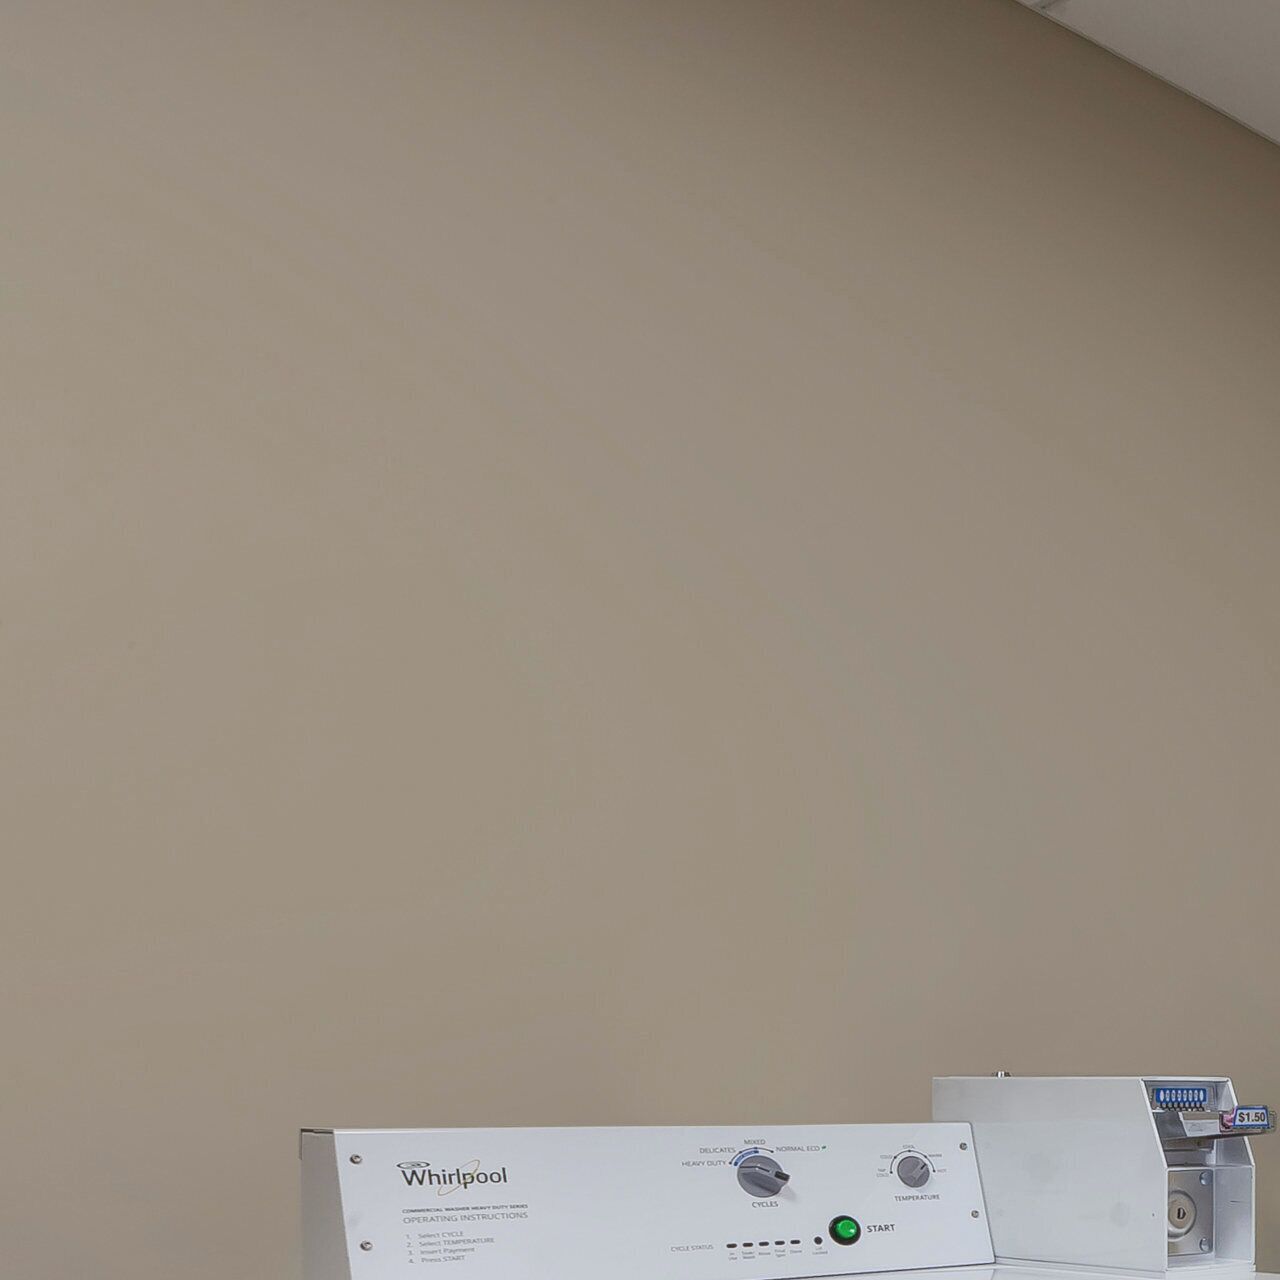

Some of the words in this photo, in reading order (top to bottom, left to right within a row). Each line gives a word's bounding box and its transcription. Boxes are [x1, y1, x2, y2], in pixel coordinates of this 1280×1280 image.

[1238, 1112, 1266, 1122] $1.50
[401, 1166, 508, 1190] Whirlpool
[894, 1194, 940, 1202] TEMPERATURE
[403, 1214, 458, 1225] OPERATING
[460, 1212, 528, 1222] INSTRUCTIONS
[867, 1224, 895, 1233] START
[443, 1238, 495, 1246] TEMPERATURE
